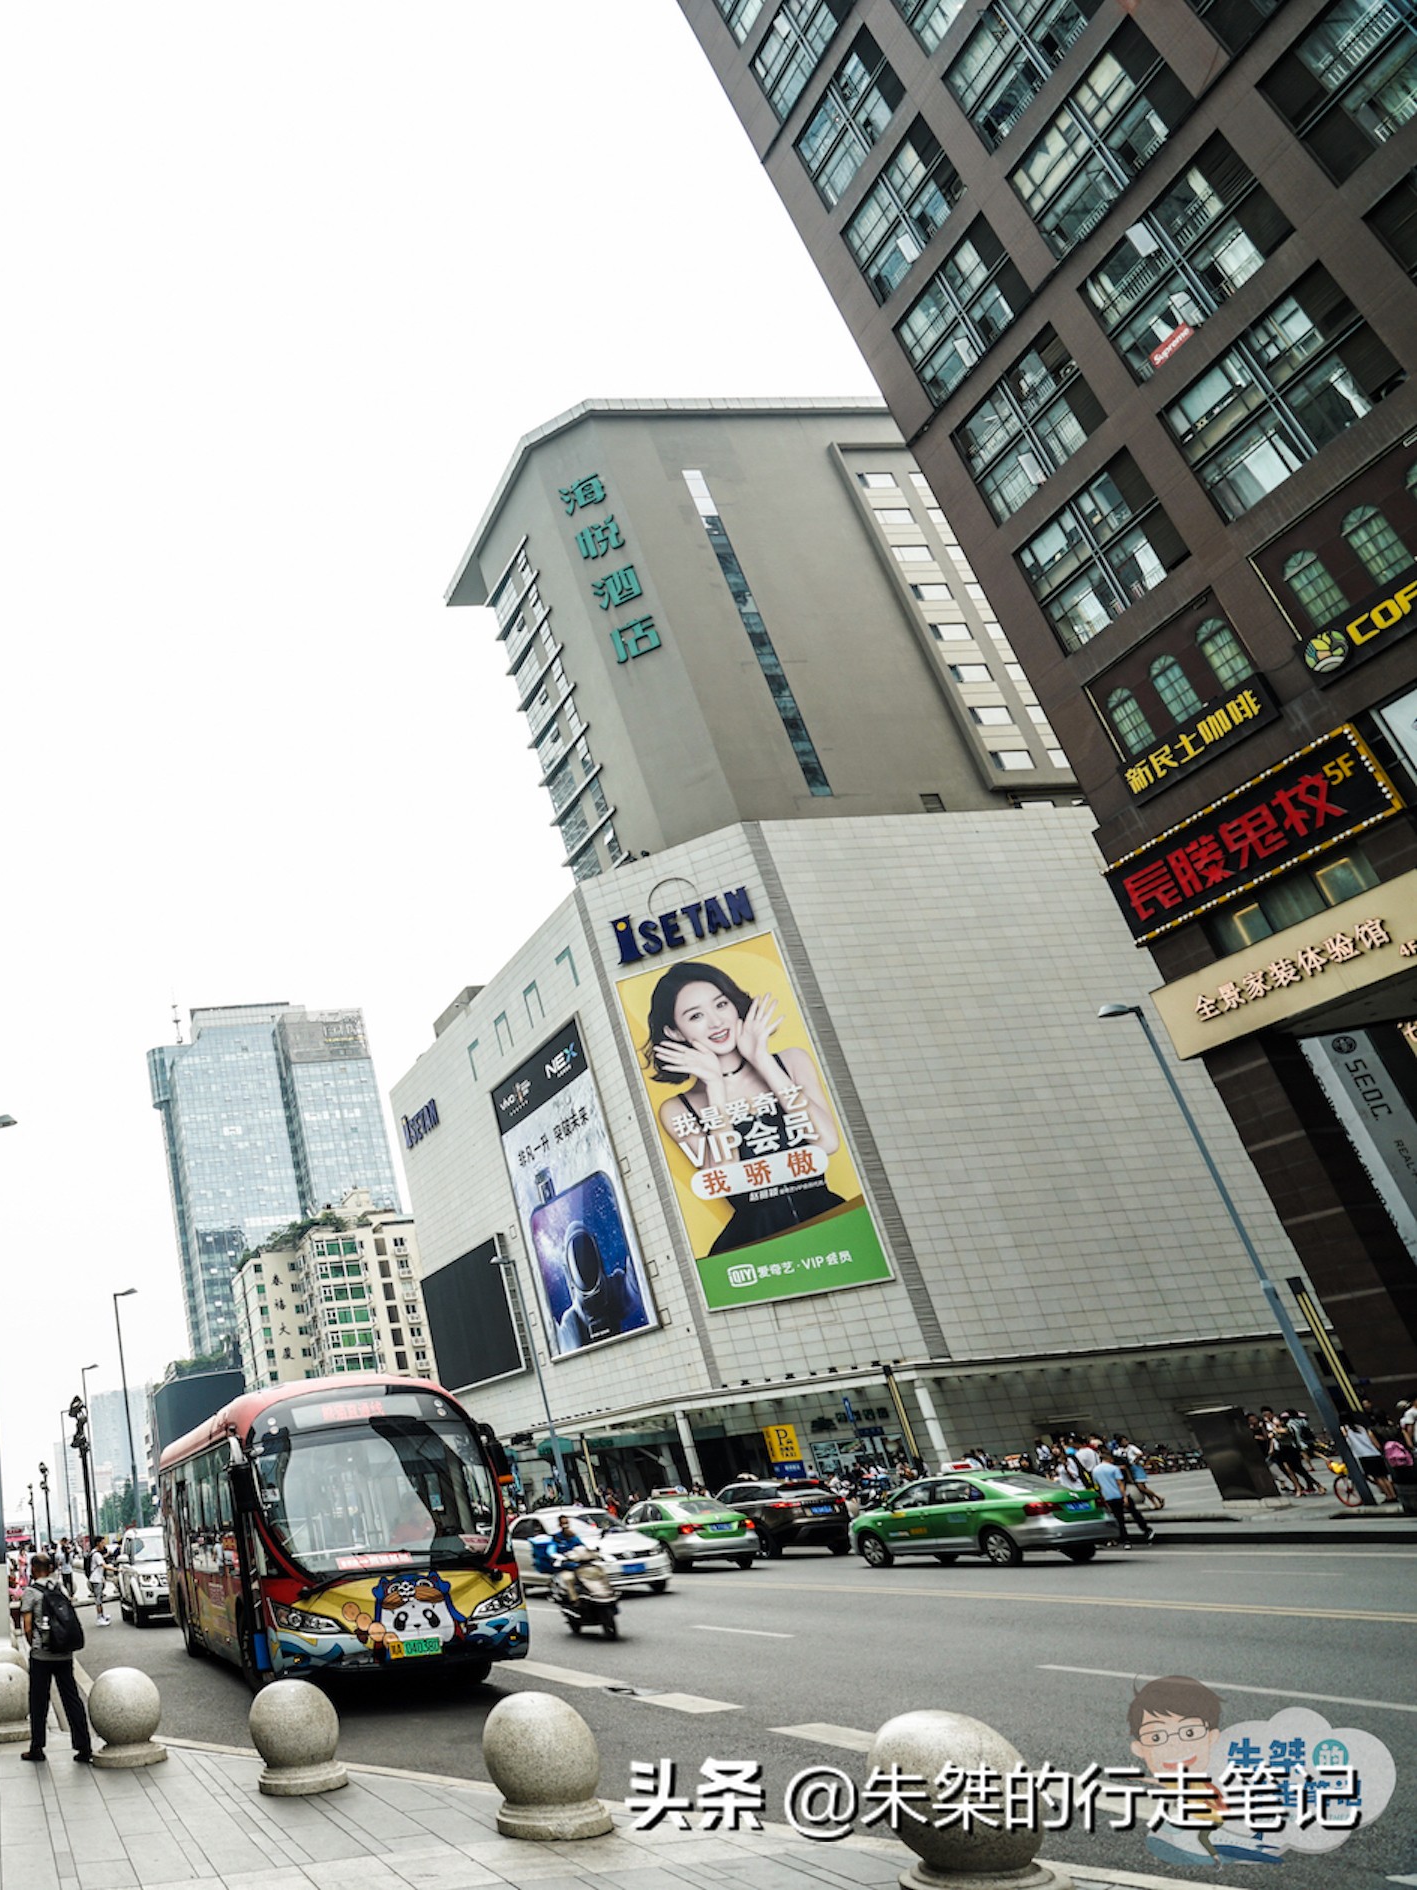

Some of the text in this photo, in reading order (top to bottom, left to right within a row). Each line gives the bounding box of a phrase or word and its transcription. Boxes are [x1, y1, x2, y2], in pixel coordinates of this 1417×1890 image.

[1154, 327, 1190, 365] Supreme
[558, 472, 662, 664] 海悦酒店
[1322, 752, 1355, 785] 5F
[610, 885, 755, 965] ISETAN
[1195, 918, 1391, 1021] 全景家装体验馆
[544, 1042, 578, 1079] NEX
[401, 1098, 440, 1149] ISETAN
[671, 1084, 809, 1138] 我是爱奇艺
[678, 1111, 820, 1168] VIP会员
